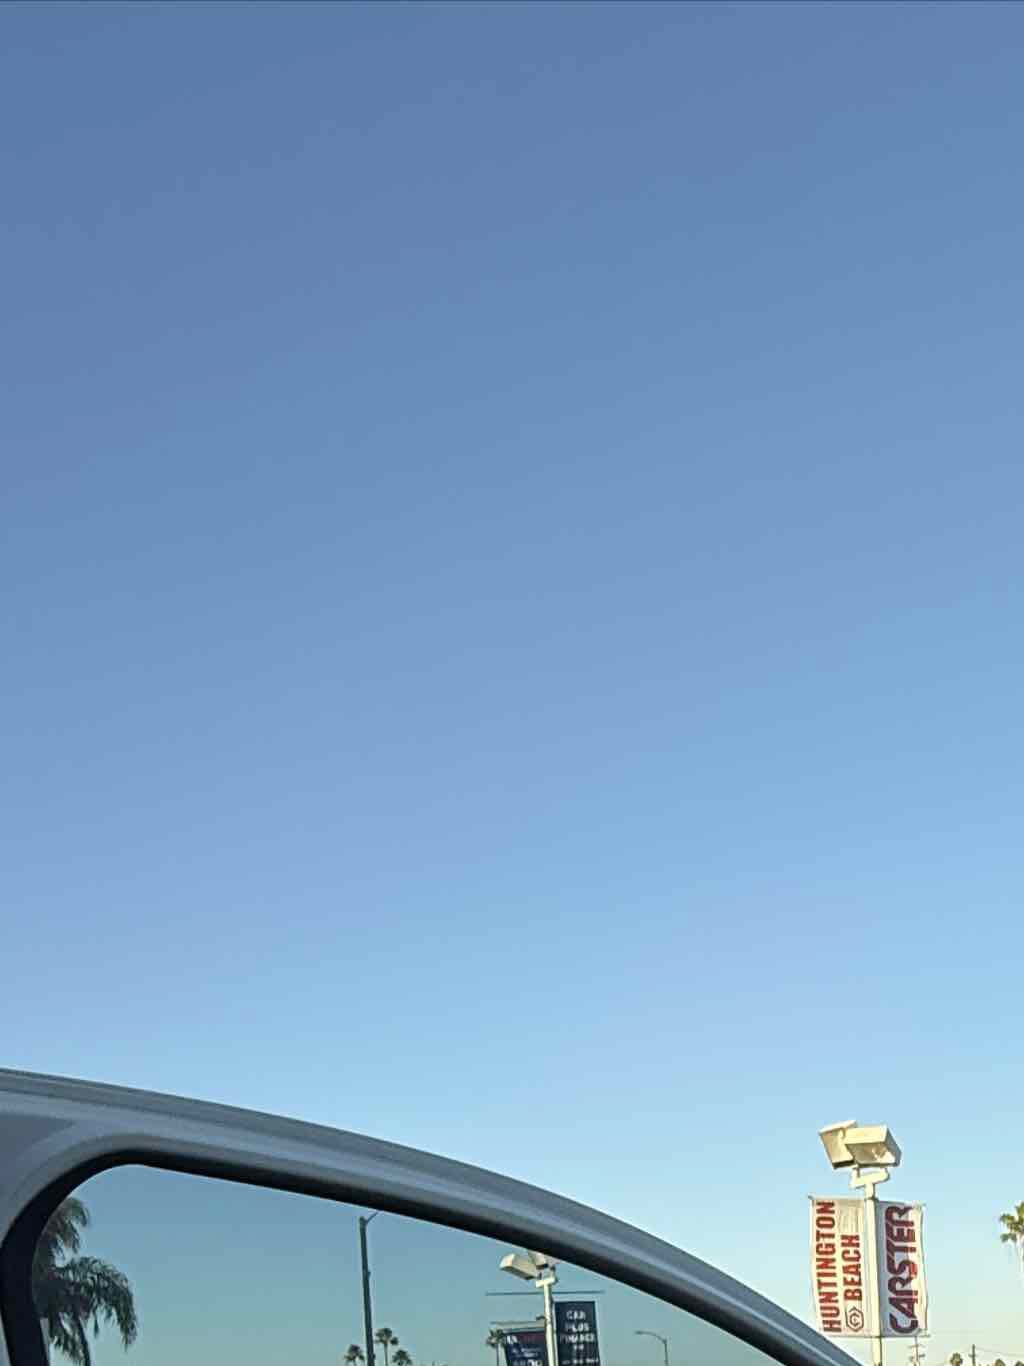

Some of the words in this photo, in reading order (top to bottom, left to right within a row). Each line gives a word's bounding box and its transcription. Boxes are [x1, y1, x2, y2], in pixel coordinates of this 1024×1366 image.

[815, 1200, 842, 1332] HUNTINGTON
[841, 1234, 863, 1302] BEACH
[885, 1205, 919, 1334] CARSTER
